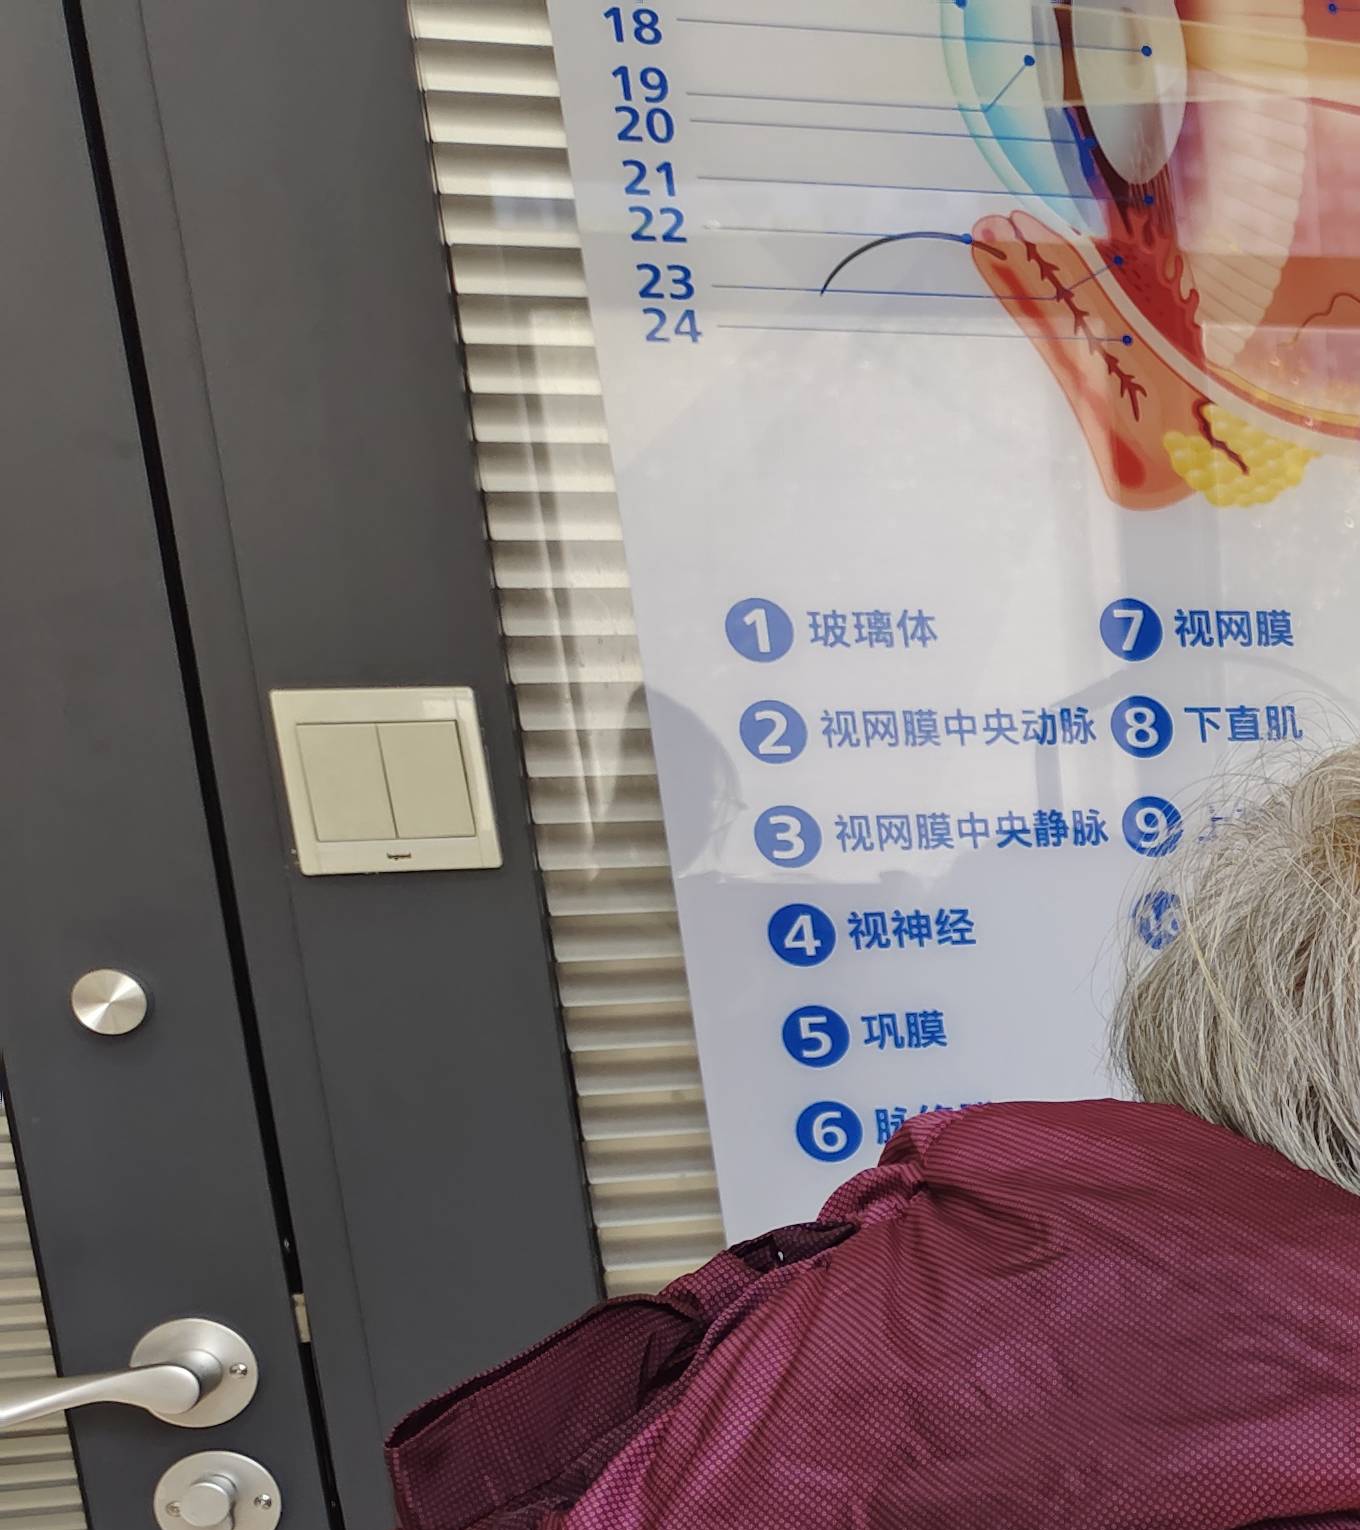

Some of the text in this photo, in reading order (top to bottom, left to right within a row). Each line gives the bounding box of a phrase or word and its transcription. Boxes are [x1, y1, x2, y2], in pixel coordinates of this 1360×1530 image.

[603, 6, 662, 45] 18
[611, 65, 669, 102] 19
[616, 105, 676, 144] 20
[621, 160, 678, 197] 21
[629, 206, 688, 243] 22
[636, 263, 695, 300] 23
[644, 307, 702, 344] 24
[808, 608, 939, 650] 玻璃体
[1174, 608, 1295, 650] 视网膜
[820, 706, 1098, 750] 视网膜中央动脉
[1184, 705, 1303, 744] 下直肌
[834, 807, 1110, 853] 视网膜中央静脉
[847, 908, 978, 951] 视神经
[861, 1010, 948, 1051] 巩膜
